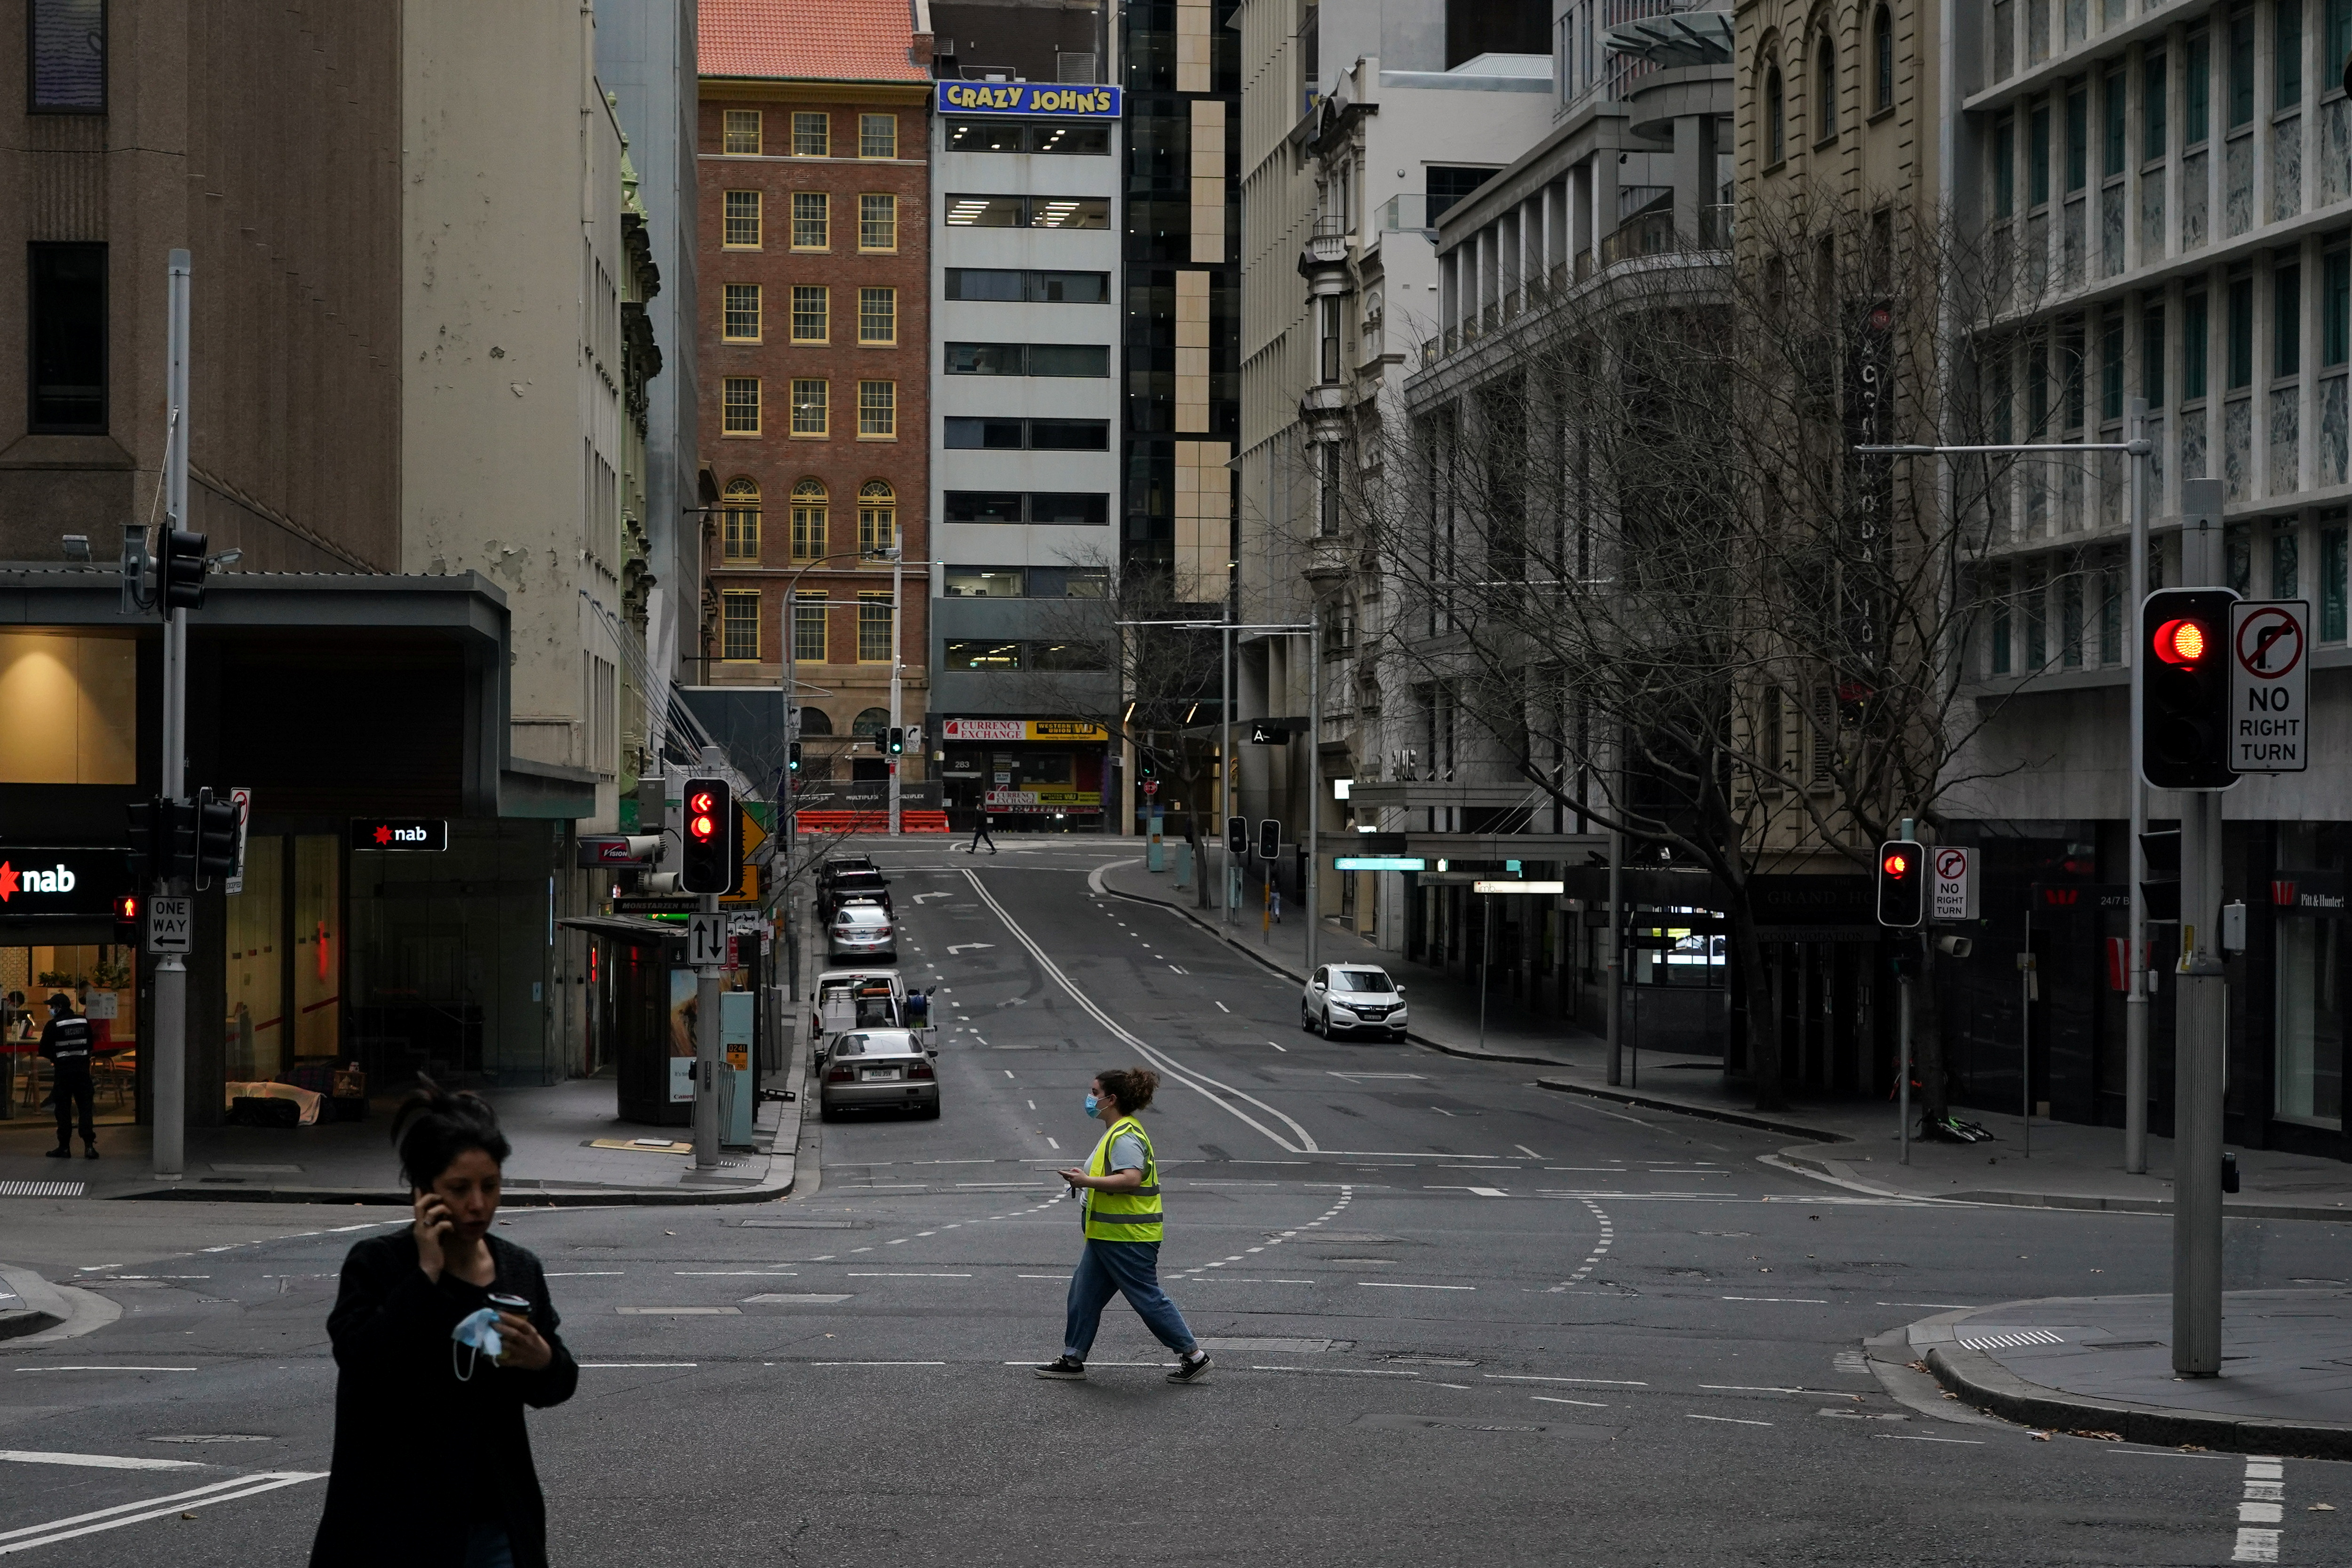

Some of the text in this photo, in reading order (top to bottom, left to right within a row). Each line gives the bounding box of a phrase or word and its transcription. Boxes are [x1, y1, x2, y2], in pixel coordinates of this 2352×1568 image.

[947, 85, 1112, 114] CRAZY JOHN'S
[2249, 687, 2289, 712] NO
[962, 721, 1022, 730] CURRENCY
[2240, 720, 2300, 737] RIGHT
[961, 730, 1022, 739] EXCHANGE
[2241, 744, 2296, 761] TURN
[395, 826, 427, 841] nab
[23, 864, 75, 892] nab
[1941, 883, 1959, 893] NO
[1767, 891, 1836, 904] GRAND
[1937, 896, 1963, 905] RIGHT
[2101, 896, 2121, 905] 24/7
[2301, 893, 2312, 906] Pitt
[2313, 894, 2319, 907] &
[156, 902, 185, 915] ONE
[153, 919, 187, 932] WAY
[64, 1027, 85, 1036] SECURITY
